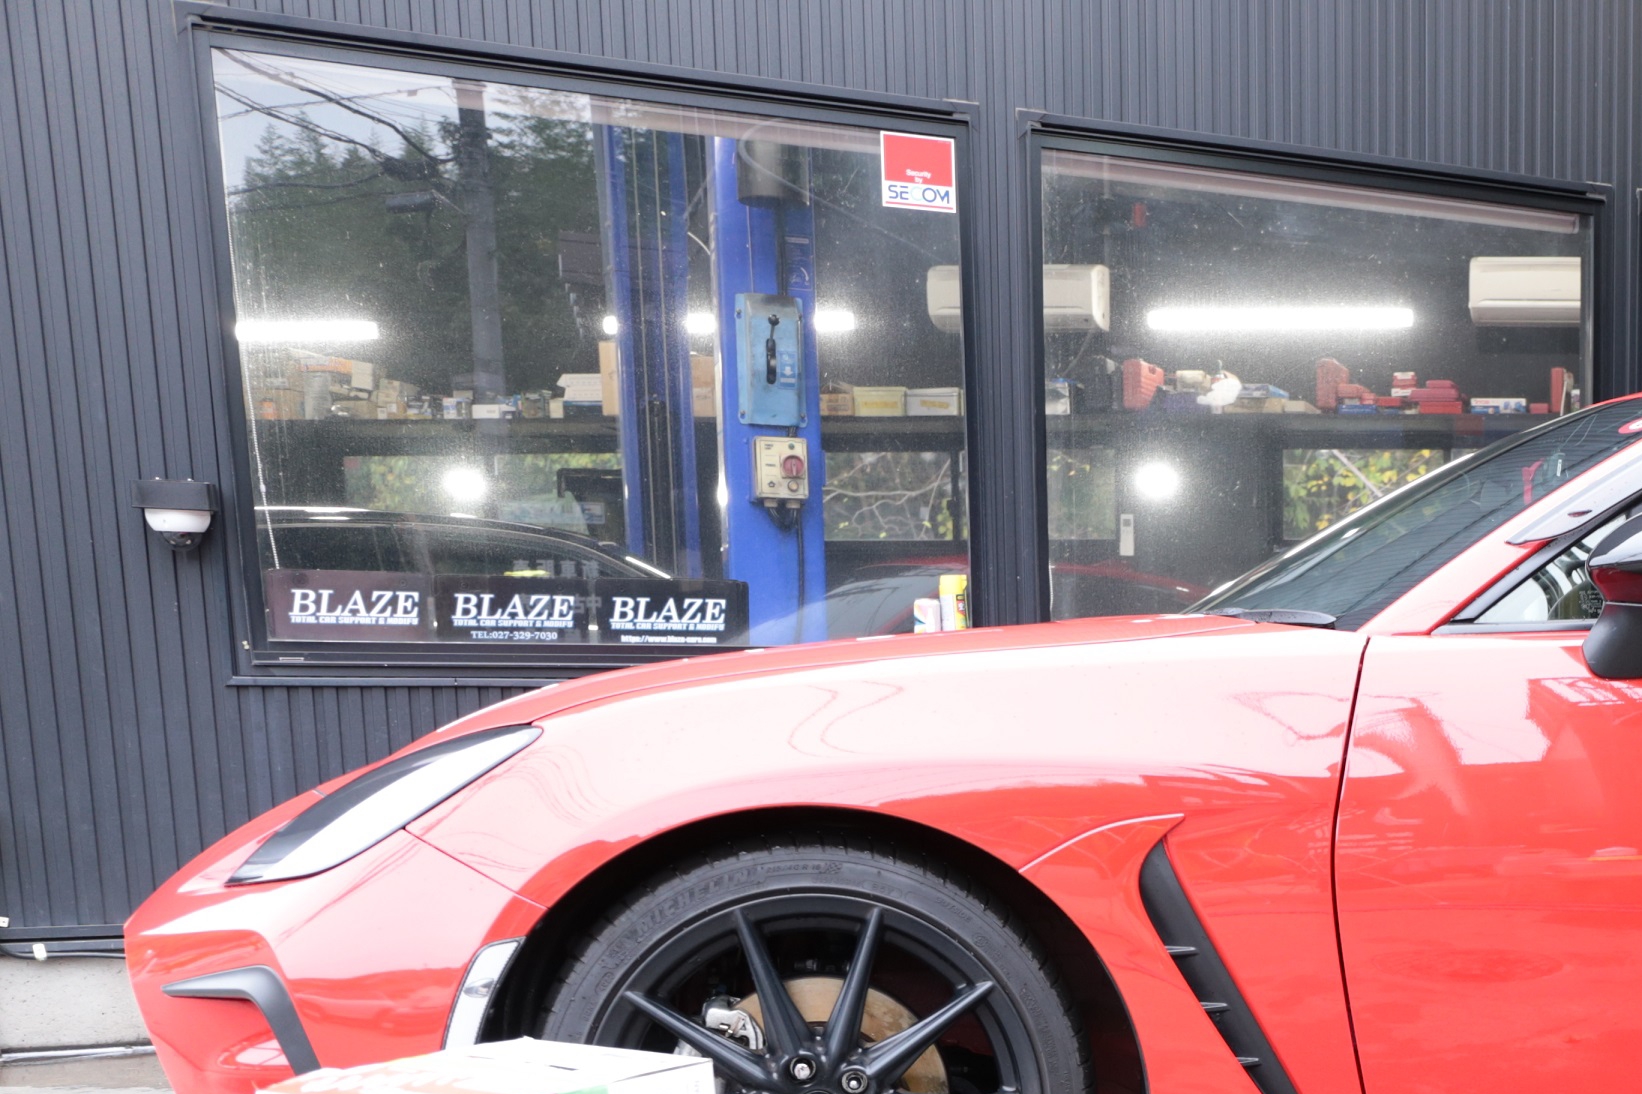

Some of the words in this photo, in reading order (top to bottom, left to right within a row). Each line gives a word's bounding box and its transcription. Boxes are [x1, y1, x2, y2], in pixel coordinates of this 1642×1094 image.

[905, 169, 931, 179] Security
[914, 176, 923, 184] by
[887, 184, 950, 204] SECOM
[288, 588, 420, 617] BLAZE
[451, 593, 575, 621] BLAZE
[609, 597, 727, 624] BLAZE
[319, 615, 337, 624] CAR
[338, 615, 377, 625] SUPPORT
[480, 618, 497, 627] CAR
[498, 618, 535, 627] SUPPORT
[636, 621, 651, 630] CAR
[653, 622, 687, 631] SUPPORT
[470, 630, 558, 641] TEL:027-329-7030
[636, 868, 751, 942] MICHELIN
